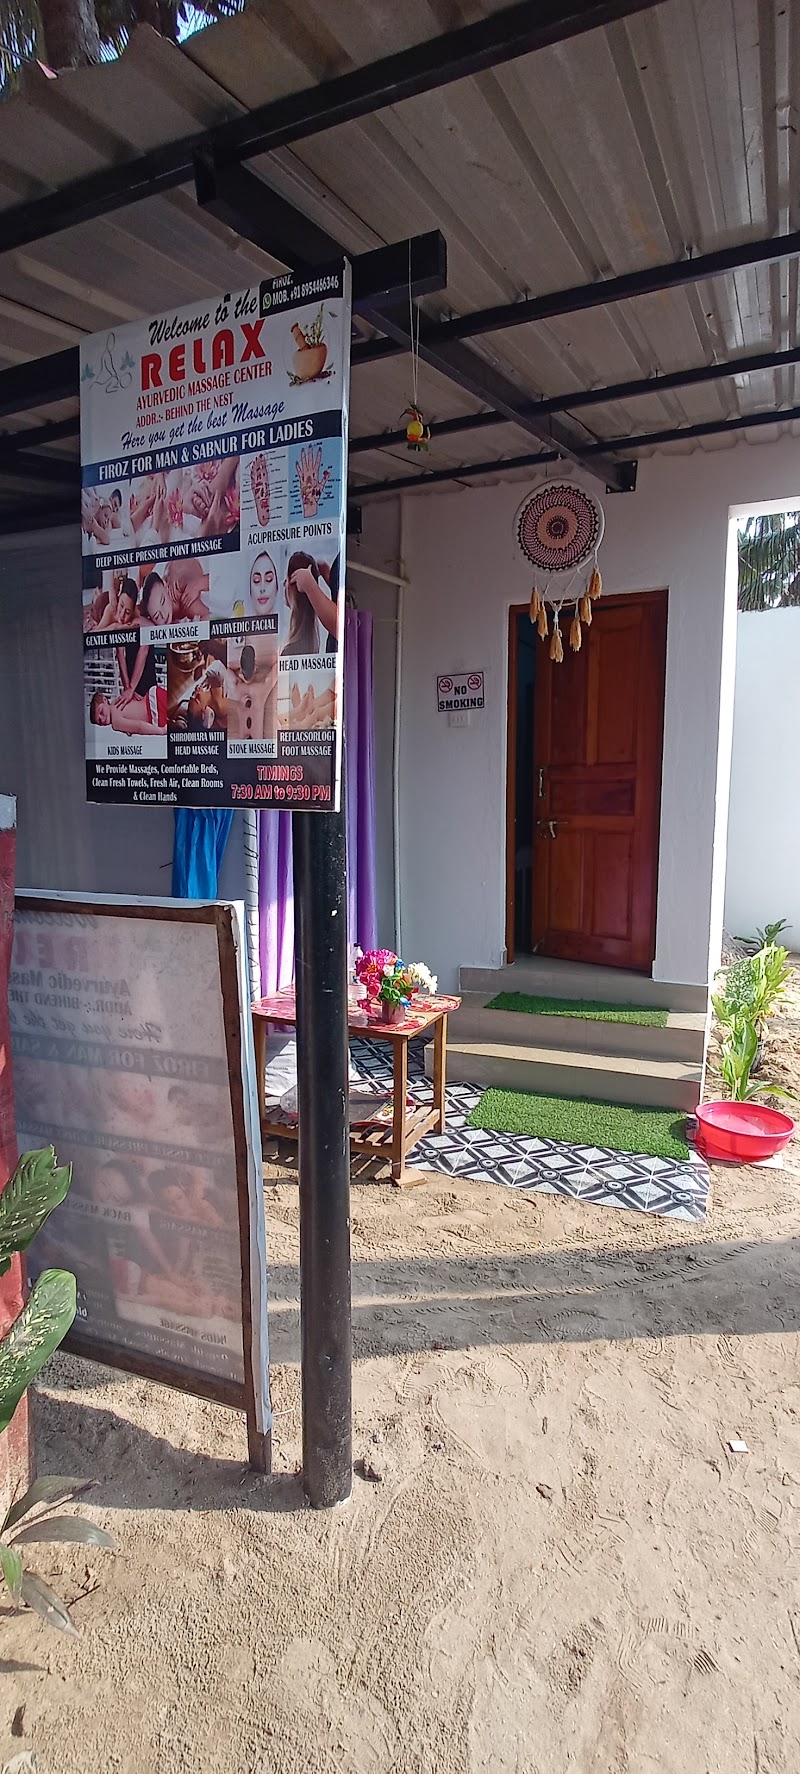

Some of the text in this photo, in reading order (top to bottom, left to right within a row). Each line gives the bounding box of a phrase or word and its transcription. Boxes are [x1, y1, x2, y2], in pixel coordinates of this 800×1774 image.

[272, 289, 289, 305] MOB.
[148, 288, 258, 346] Welcome to the
[141, 319, 266, 391] RELAX
[136, 361, 273, 411] AYURVEDIC MASSAGE CENTER
[165, 403, 194, 421] BEHIND
[196, 399, 211, 412] THE
[213, 392, 235, 408] NEST
[121, 401, 285, 450] Here you get the best Massage
[99, 419, 315, 481] FIROZ FOR MAN & SABNUR FOR LADIES
[247, 522, 332, 546] ACUPRESSURE POINTS
[95, 538, 223, 568] DEEP TISSUE PRESSURE POINT MASSAGE
[150, 626, 199, 641] BACK MASSAGE
[211, 618, 277, 636] AYURVEDIC FACIAL
[85, 631, 138, 646] GENTLE MASSAGE
[279, 657, 336, 672] HEAD MASSAGE
[454, 685, 467, 696] NO
[439, 697, 483, 710] SMOKING
[170, 731, 225, 743] SHIRODHARA WITH
[107, 745, 143, 756] KIDS MASSAGE
[174, 745, 220, 756] HEAD MASSAGE
[229, 743, 276, 755] STONE MASSAGE
[281, 745, 332, 756] FOOT MASSAGE
[95, 763, 219, 776] We Provide Massages, Comfortable Beds,
[256, 765, 304, 781] TIMINGS
[92, 778, 224, 789] Clean Fresh Towels, Fresh Air, Clean Rooms
[133, 791, 178, 802] & Clean Hands
[231, 784, 331, 801] 7:30 AM to 9:30 PM
